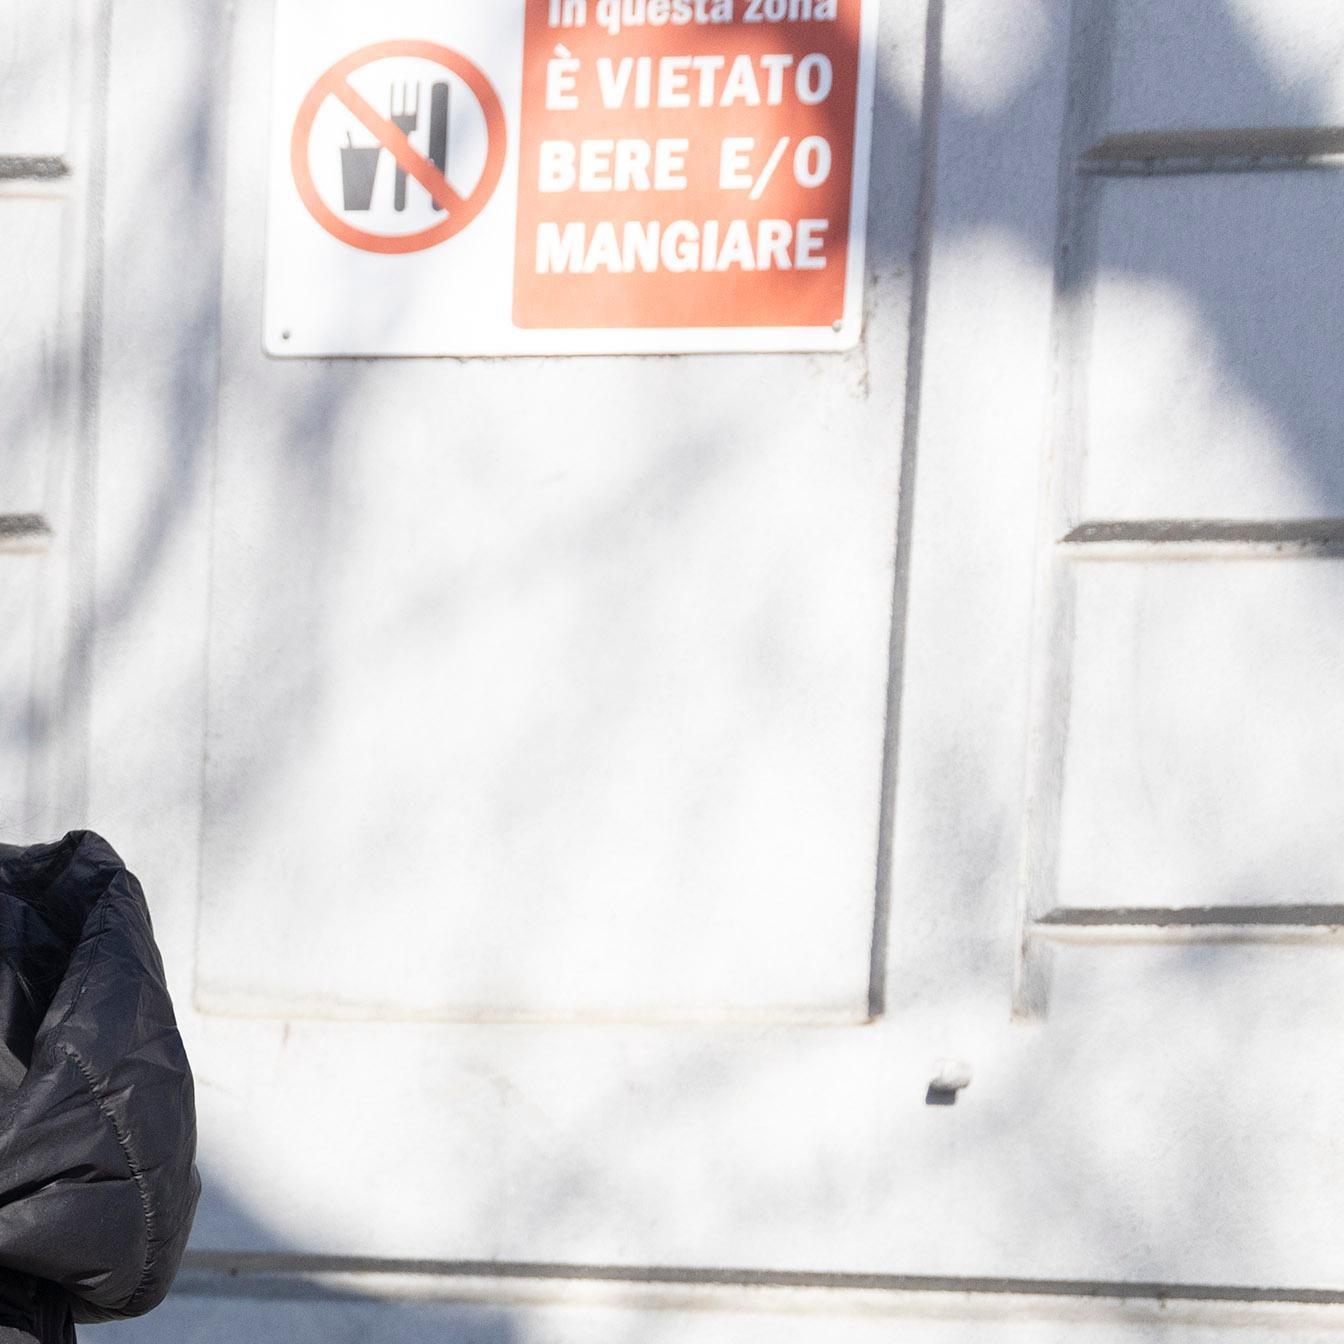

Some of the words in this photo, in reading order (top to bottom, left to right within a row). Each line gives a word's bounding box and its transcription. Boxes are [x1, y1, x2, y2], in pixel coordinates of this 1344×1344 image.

[545, 43, 581, 110] È
[596, 53, 833, 109] VIETATO
[538, 138, 689, 193] BERE
[719, 135, 832, 201] E/O
[535, 218, 829, 274] MANGIARE
